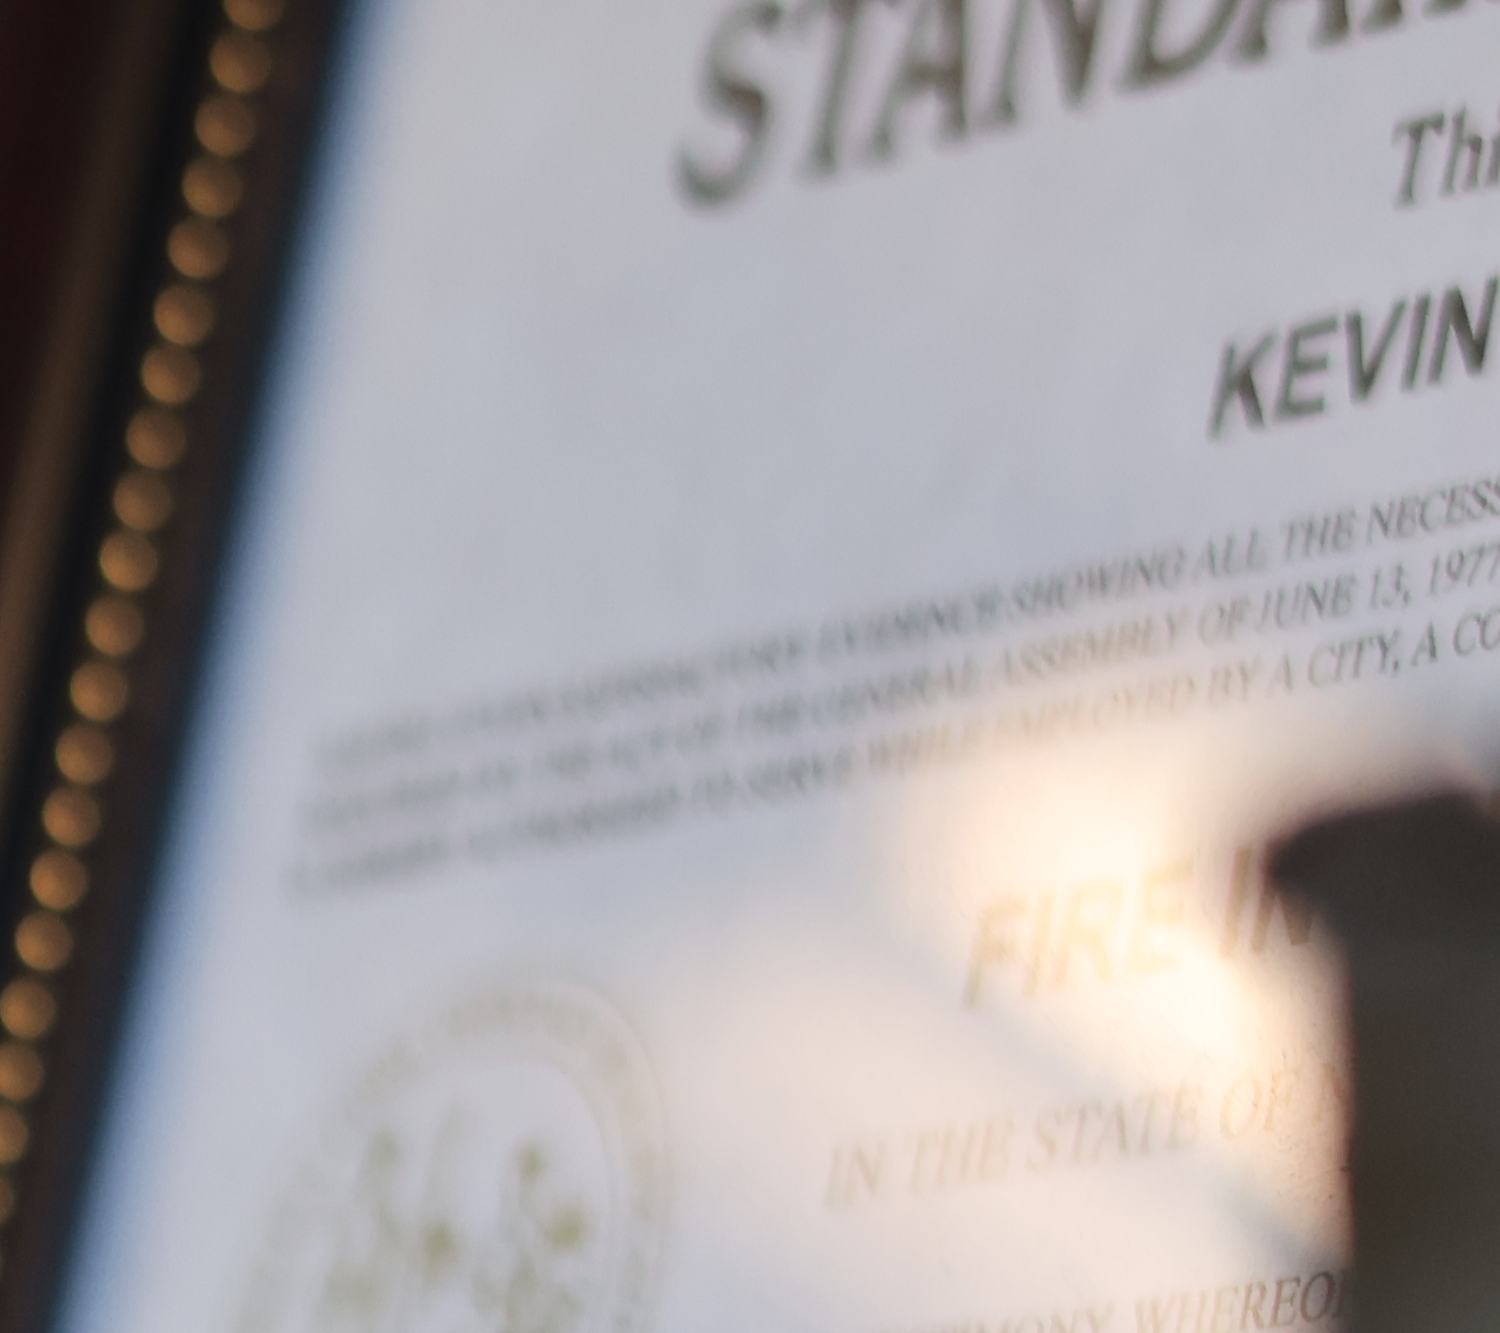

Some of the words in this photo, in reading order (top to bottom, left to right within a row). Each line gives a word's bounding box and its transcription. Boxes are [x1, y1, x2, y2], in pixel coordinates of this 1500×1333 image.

[1206, 270, 1500, 440] KEVIN
[1190, 527, 1268, 582] ALL
[1280, 506, 1358, 564] THE
[1366, 474, 1500, 548] NECES
[1208, 655, 1263, 702] BY
[1268, 652, 1296, 694] A
[1308, 628, 1402, 688] CITY,
[1411, 619, 1440, 667] A
[1255, 573, 1358, 634] JUNE
[962, 855, 1196, 1012] FIRE
[826, 1138, 888, 1209] IN
[905, 1112, 1016, 1195] THE
[1027, 1080, 1204, 1178] STATE
[1218, 1063, 1304, 1142] OF
